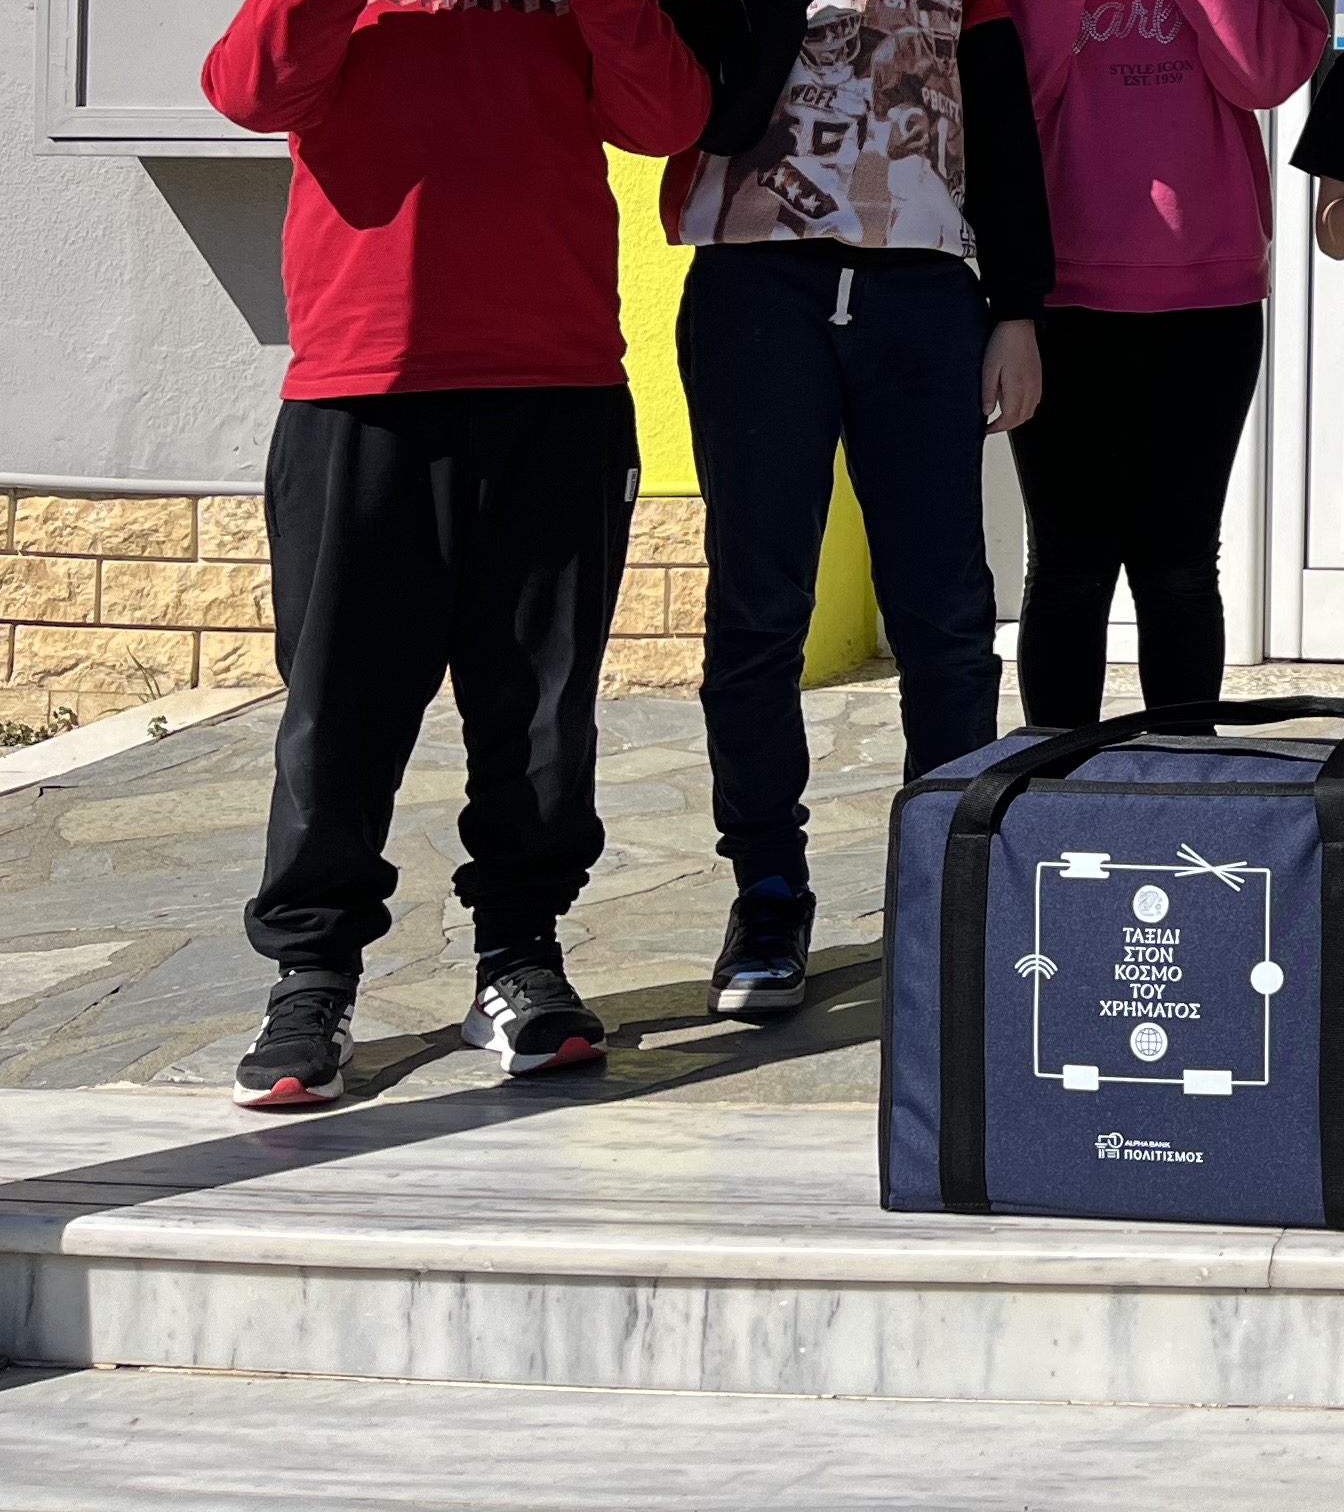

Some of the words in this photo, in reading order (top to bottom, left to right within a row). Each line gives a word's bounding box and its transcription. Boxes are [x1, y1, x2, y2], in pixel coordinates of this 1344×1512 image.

[1110, 62, 1154, 76] STYLE
[1122, 926, 1181, 945] ΤΑΞΙΔΙ
[1123, 946, 1174, 963] ΣΤΟΝ
[1114, 964, 1182, 983] ΚΟΣΜΟ
[1129, 983, 1166, 1000] ΤΟΥ
[1099, 1000, 1201, 1019] ΧΡΗΜΑΤΟΣ
[1124, 1140, 1149, 1148] ALPHA
[1149, 1141, 1171, 1149] BANK
[1123, 1150, 1204, 1163] ΠΟΛΙΤΙΣΜΟΣ
